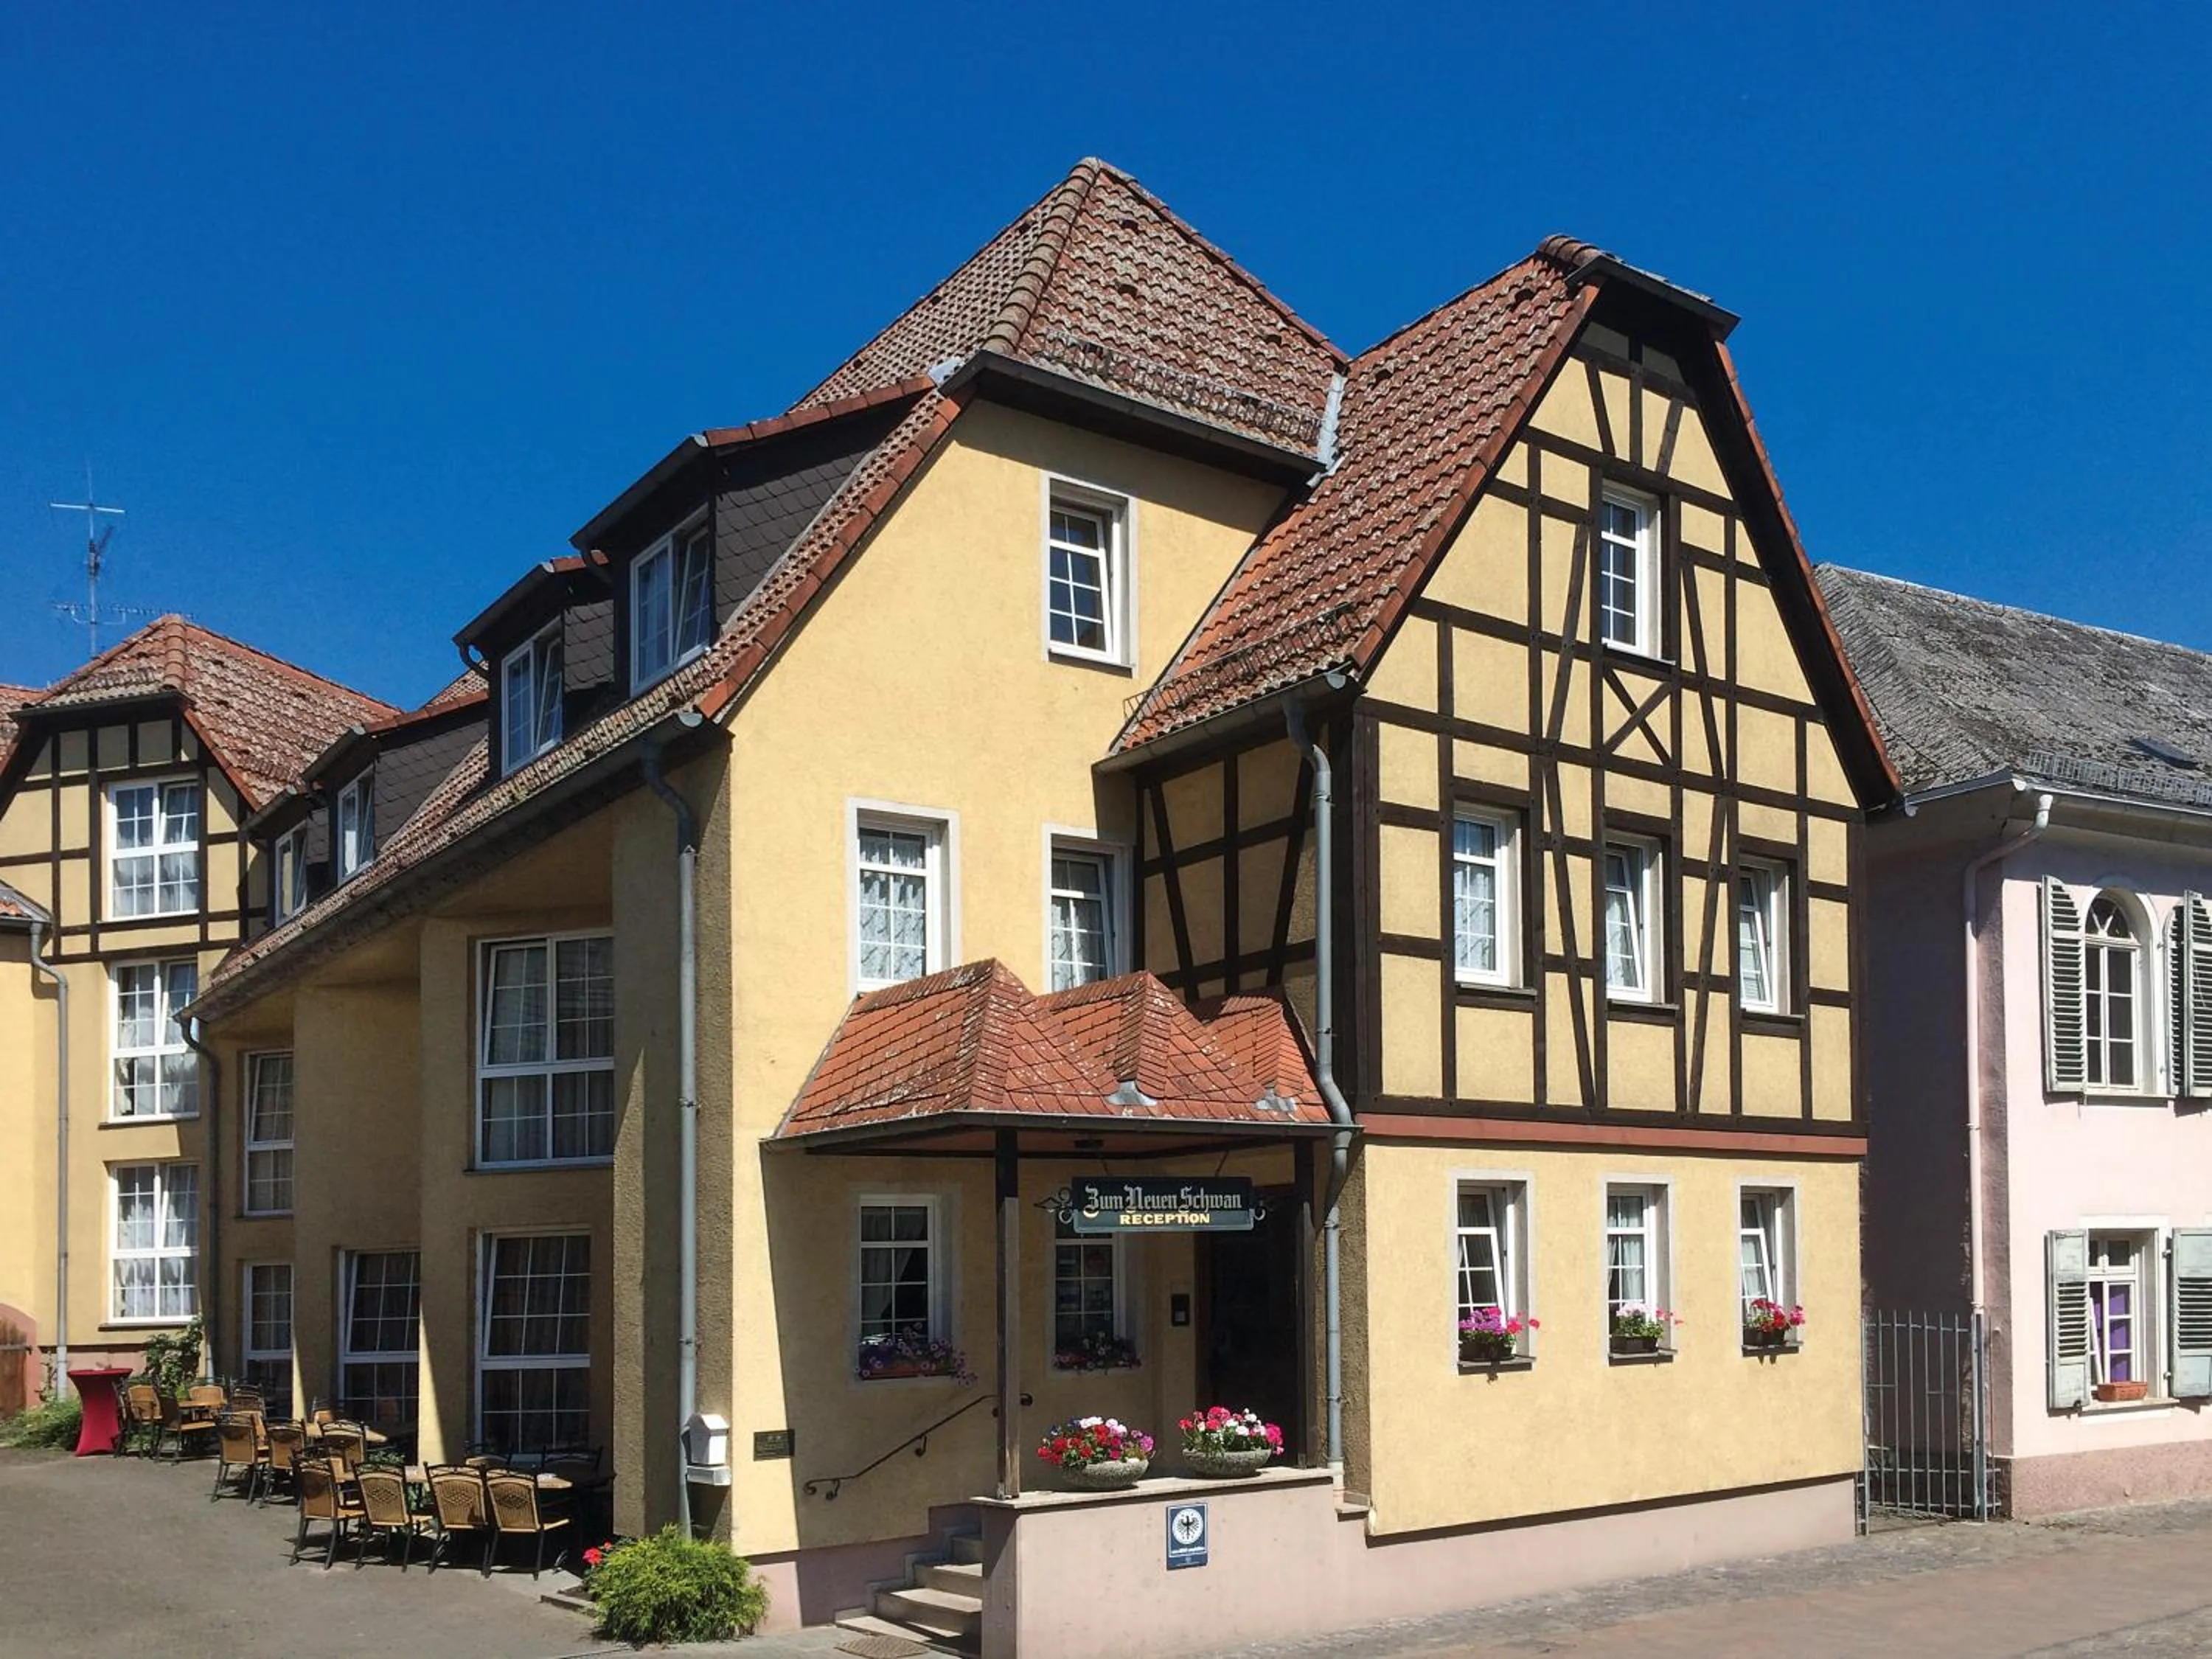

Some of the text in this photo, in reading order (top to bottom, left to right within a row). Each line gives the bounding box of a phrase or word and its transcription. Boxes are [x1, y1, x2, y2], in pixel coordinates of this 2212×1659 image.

[1083, 1184, 1242, 1217] Zum Neuen Schwan
[1120, 1213, 1210, 1225] RECEPTION
